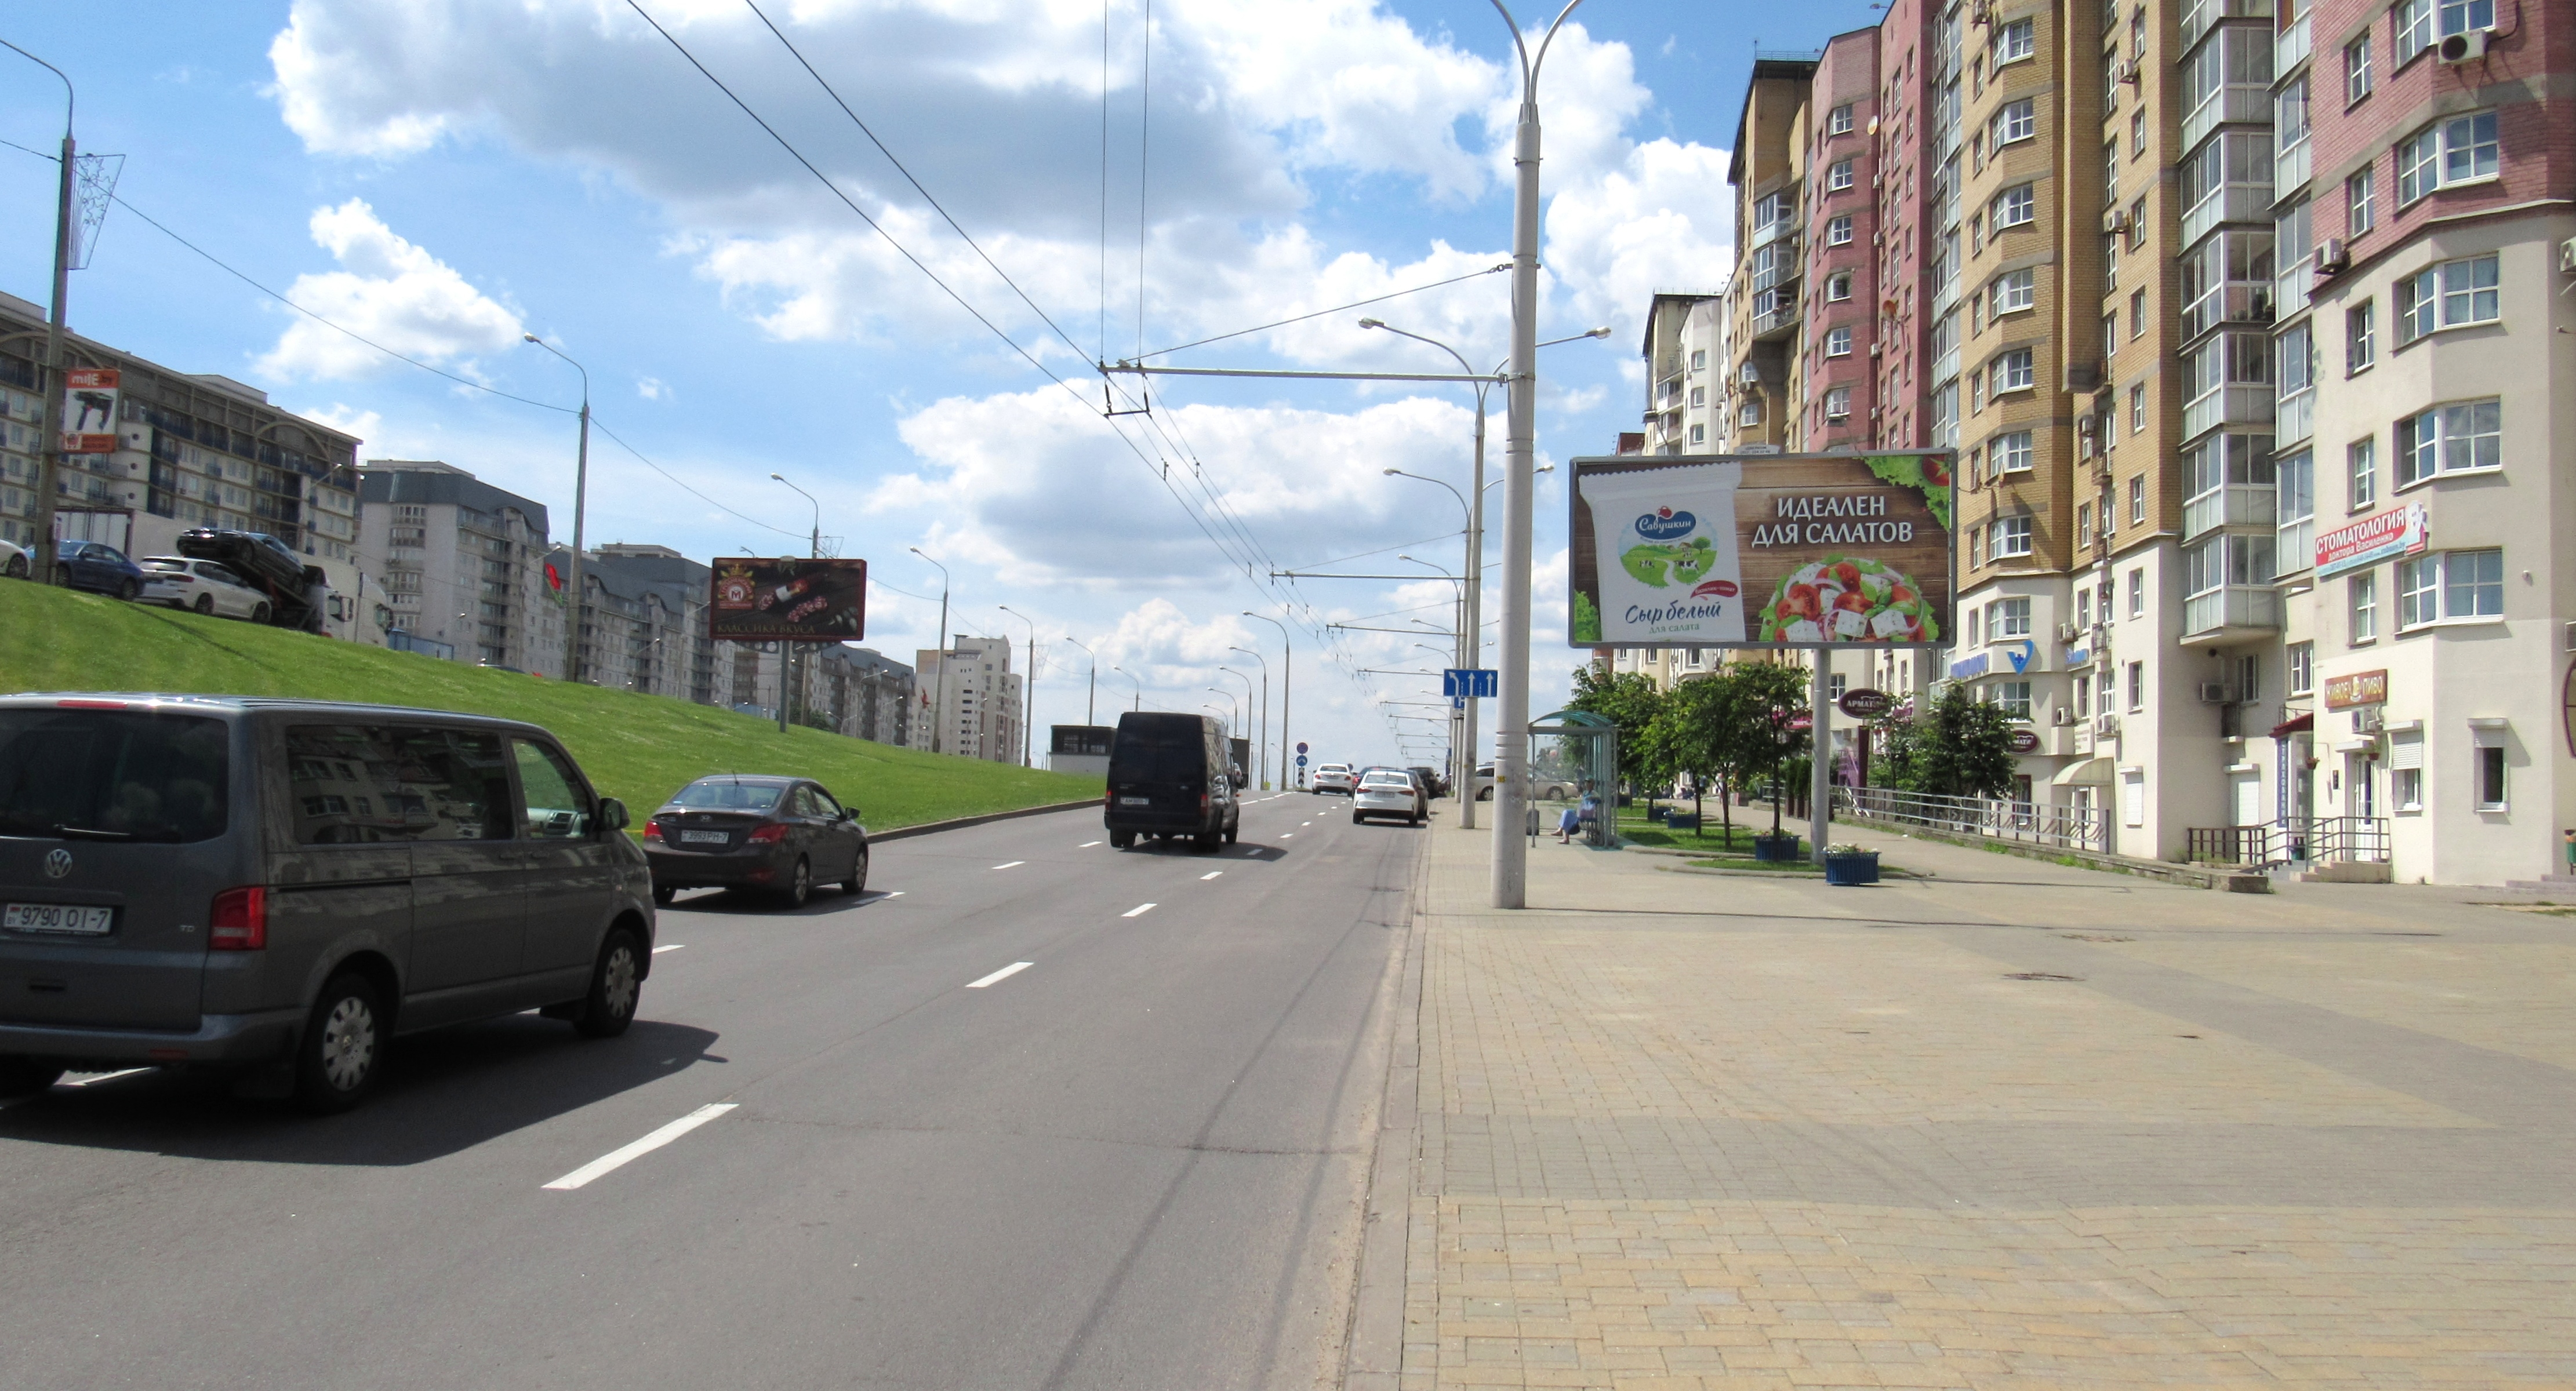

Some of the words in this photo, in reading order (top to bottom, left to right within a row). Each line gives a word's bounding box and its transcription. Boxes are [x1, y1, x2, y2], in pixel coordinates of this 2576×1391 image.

[1778, 496, 1884, 521] ИДЕАЛЕН
[1639, 518, 1691, 534] Савушкин
[1751, 523, 1798, 548] ДЛЯ
[1805, 522, 1912, 544] САЛАТОВ
[2316, 509, 2405, 555] СТОМАТОЛОГИЯ
[2356, 532, 2394, 552] Василенко
[1625, 605, 1662, 625] Сыр
[1666, 599, 1721, 621] белый
[718, 624, 776, 633] КЛАССИКА
[780, 624, 815, 633] ВКУСА
[1649, 626, 1666, 634] для
[1669, 623, 1699, 632] салата
[2363, 676, 2382, 696] ПИВО
[21, 906, 60, 926] 9790
